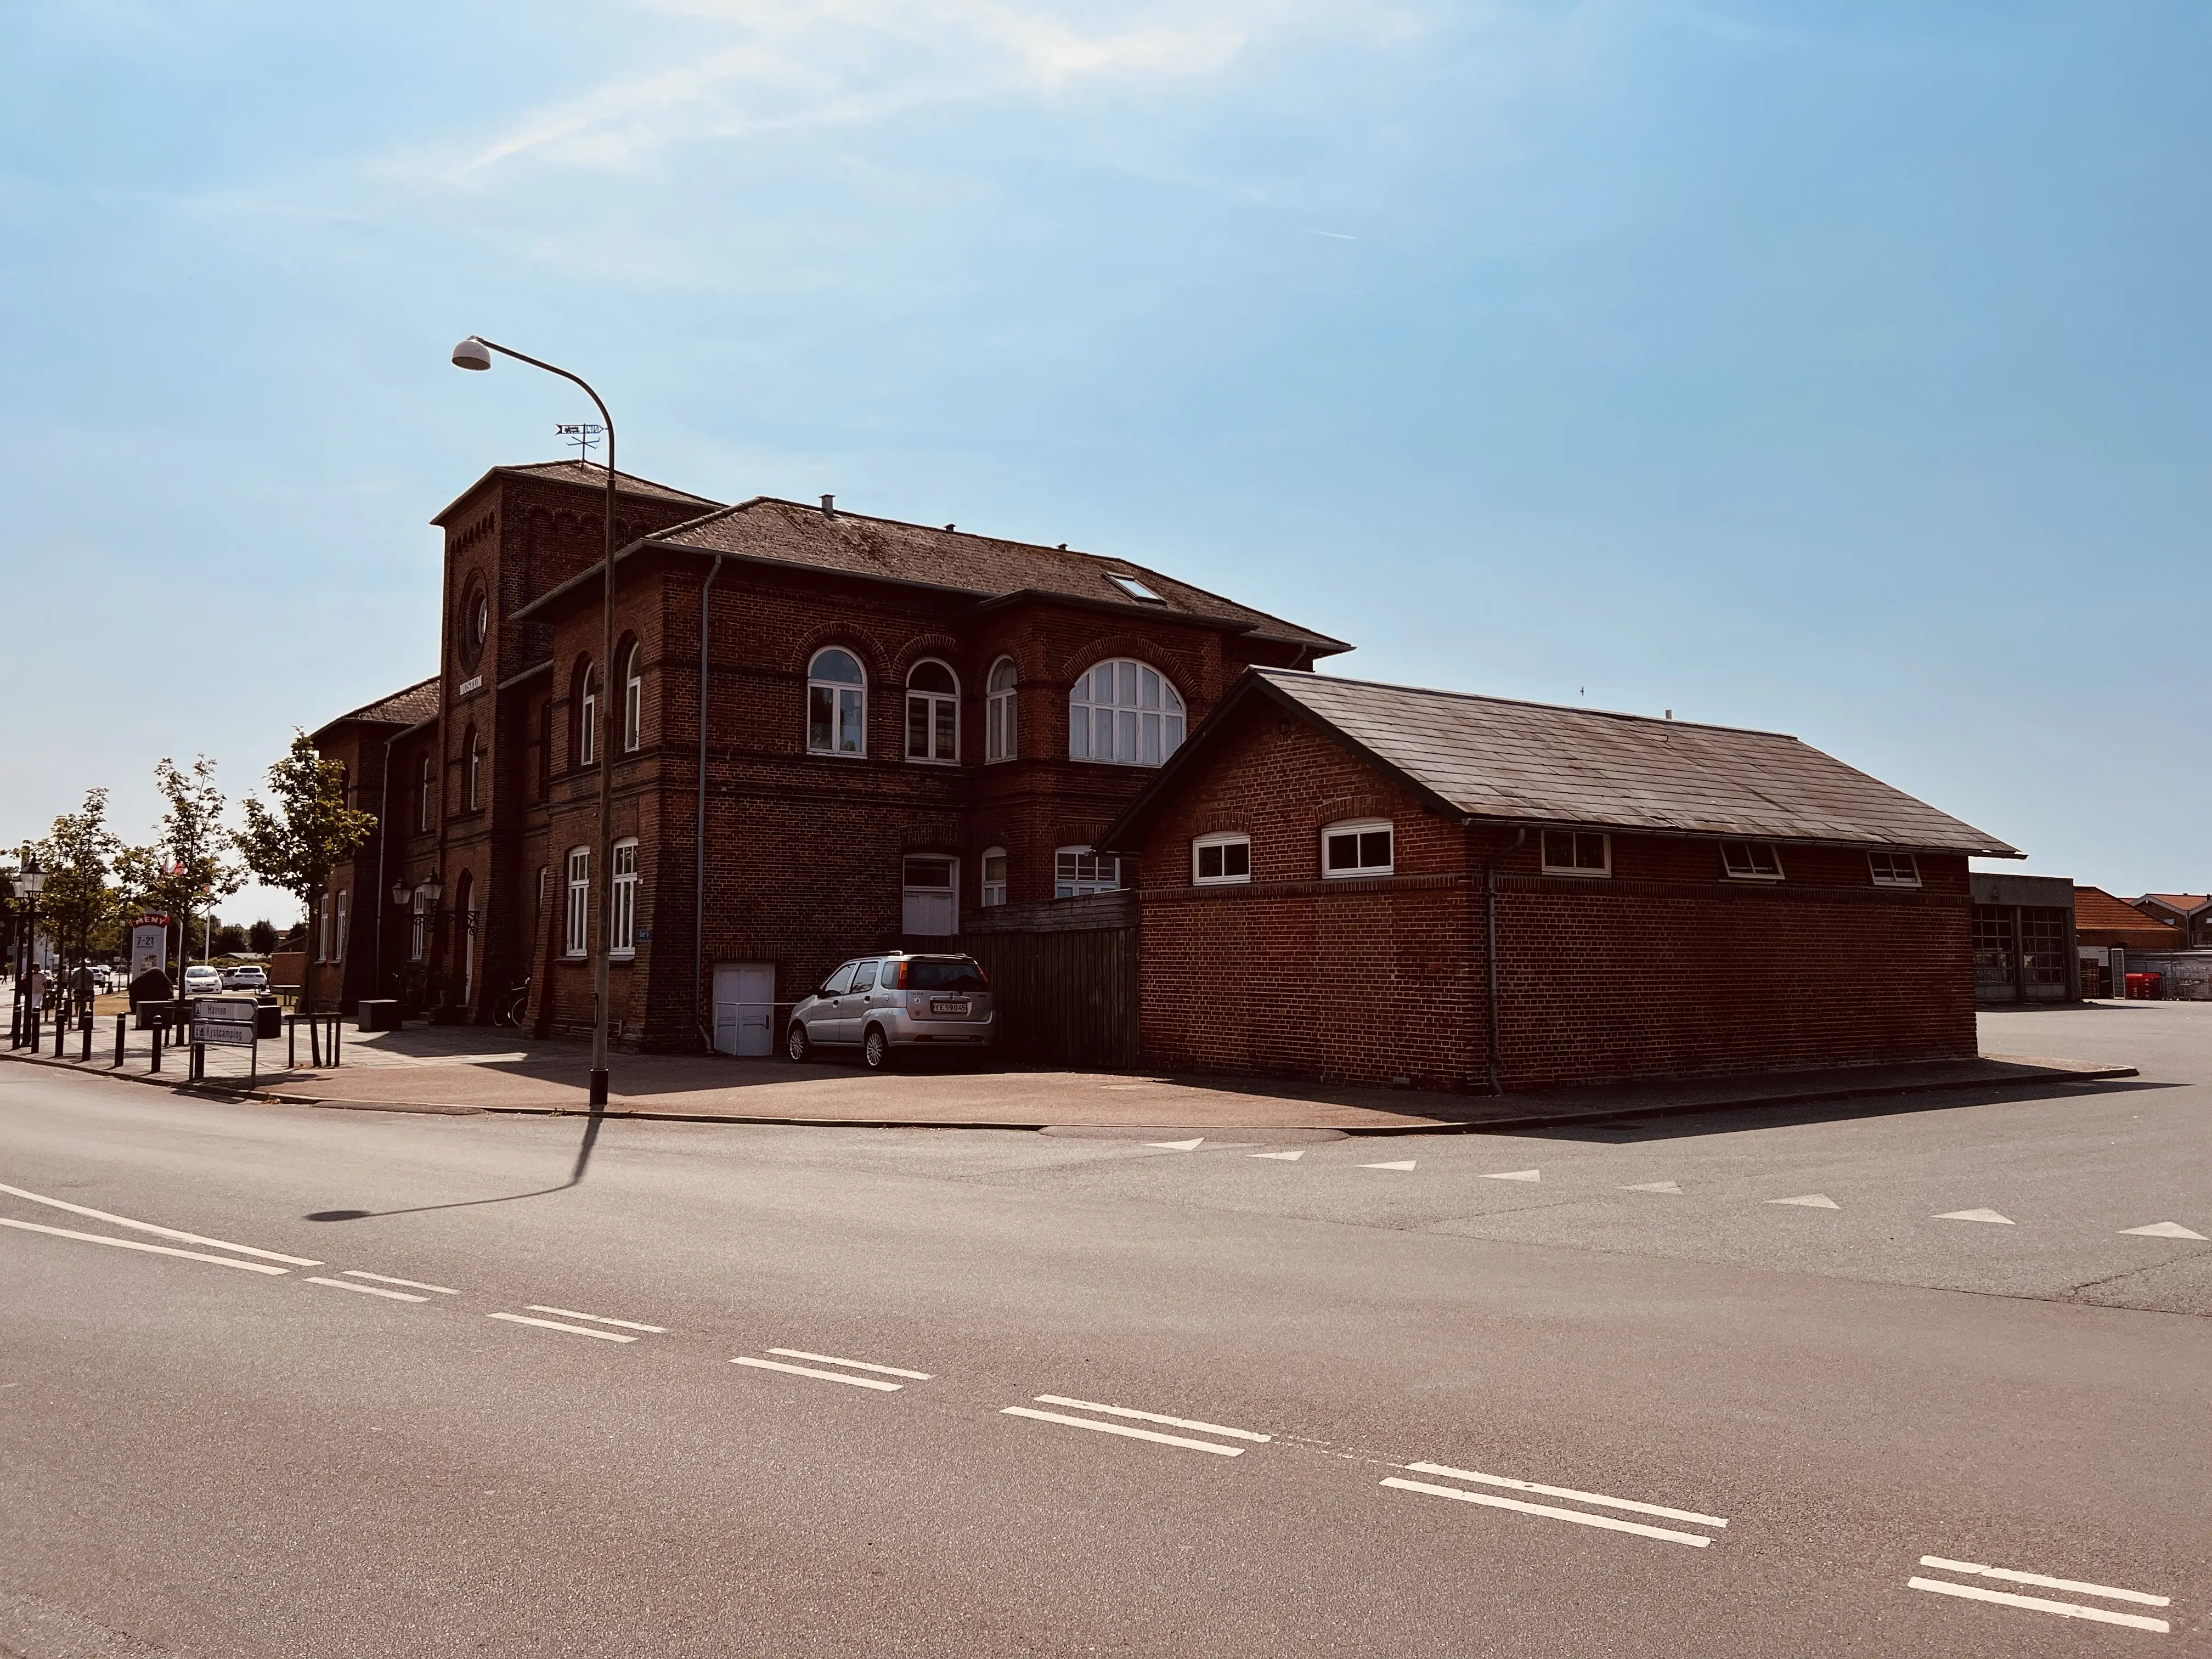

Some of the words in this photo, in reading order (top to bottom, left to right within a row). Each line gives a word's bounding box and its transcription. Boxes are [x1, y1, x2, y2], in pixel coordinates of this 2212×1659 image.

[460, 675, 482, 696] MUSEUM
[136, 916, 165, 924] MENY
[137, 937, 154, 945] 7-21
[206, 1026, 242, 1041] Kystcamping
